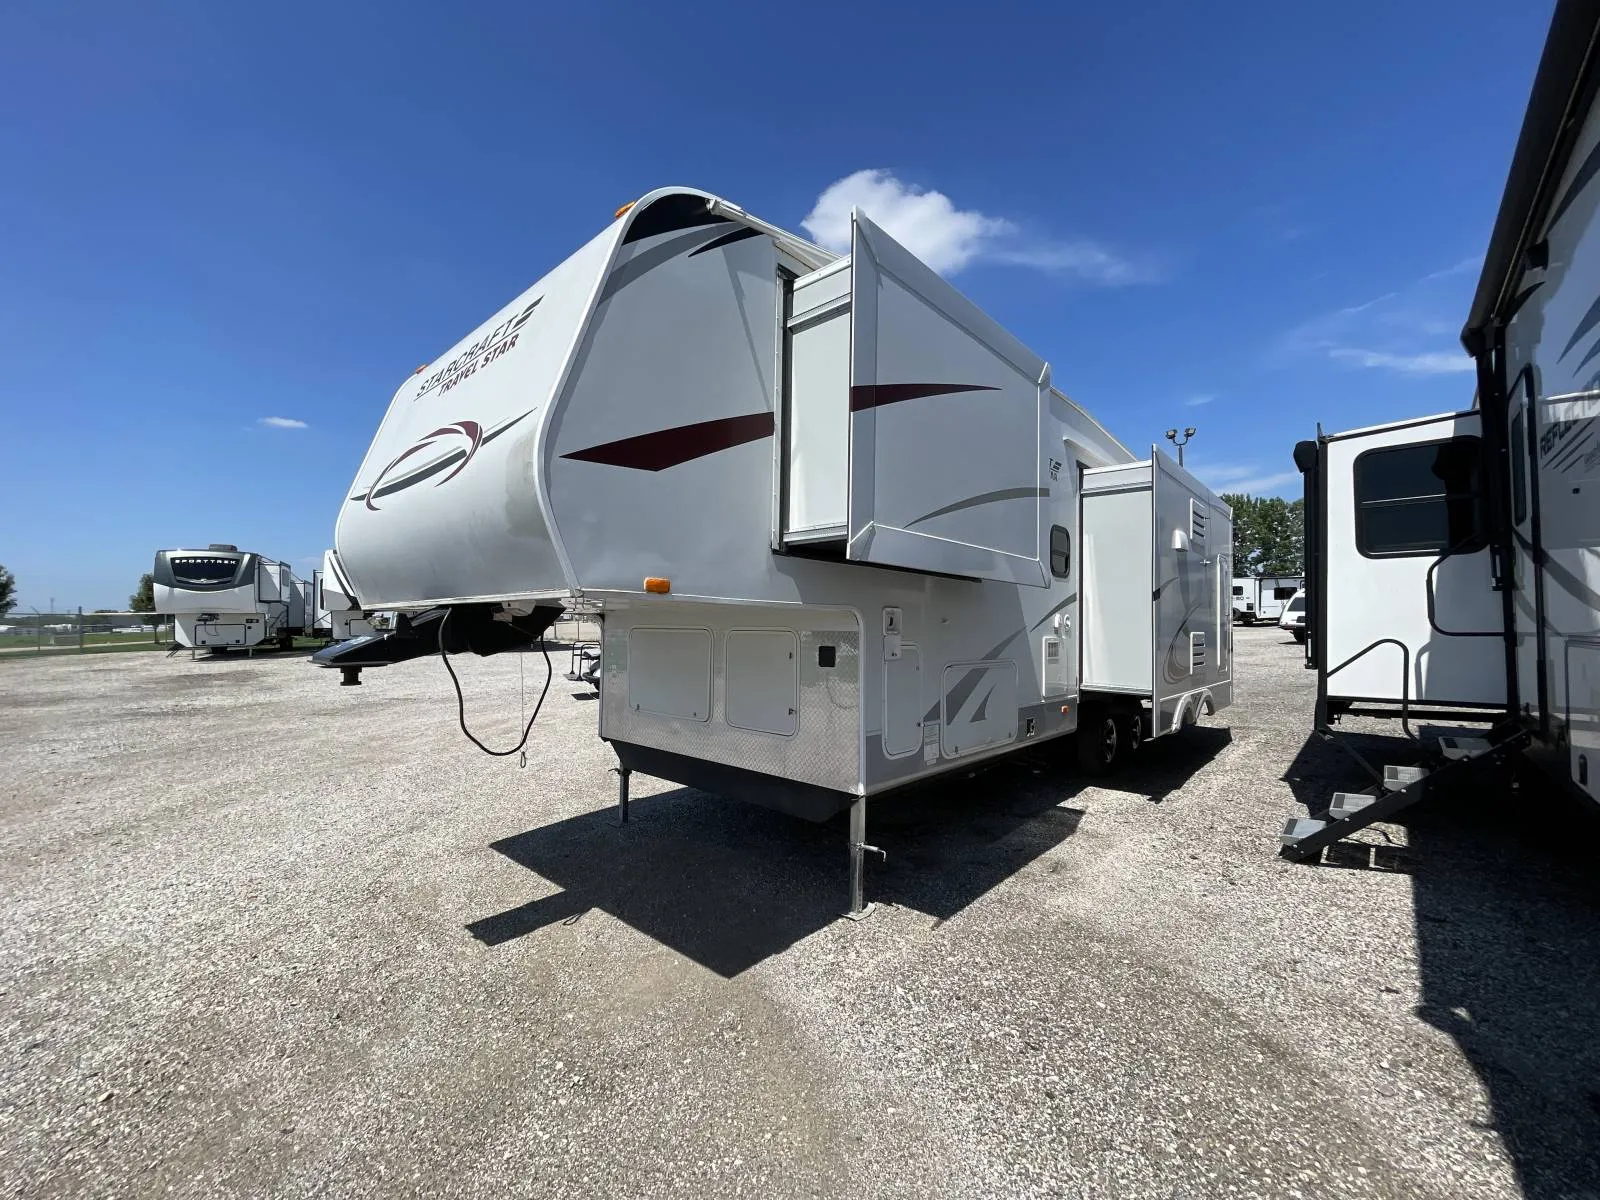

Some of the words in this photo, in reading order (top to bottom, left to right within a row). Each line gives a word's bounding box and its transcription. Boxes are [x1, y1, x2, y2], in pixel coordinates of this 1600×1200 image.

[416, 313, 519, 397] STARCRAFT
[438, 361, 478, 396] TRAVEL
[481, 333, 519, 368] STAR
